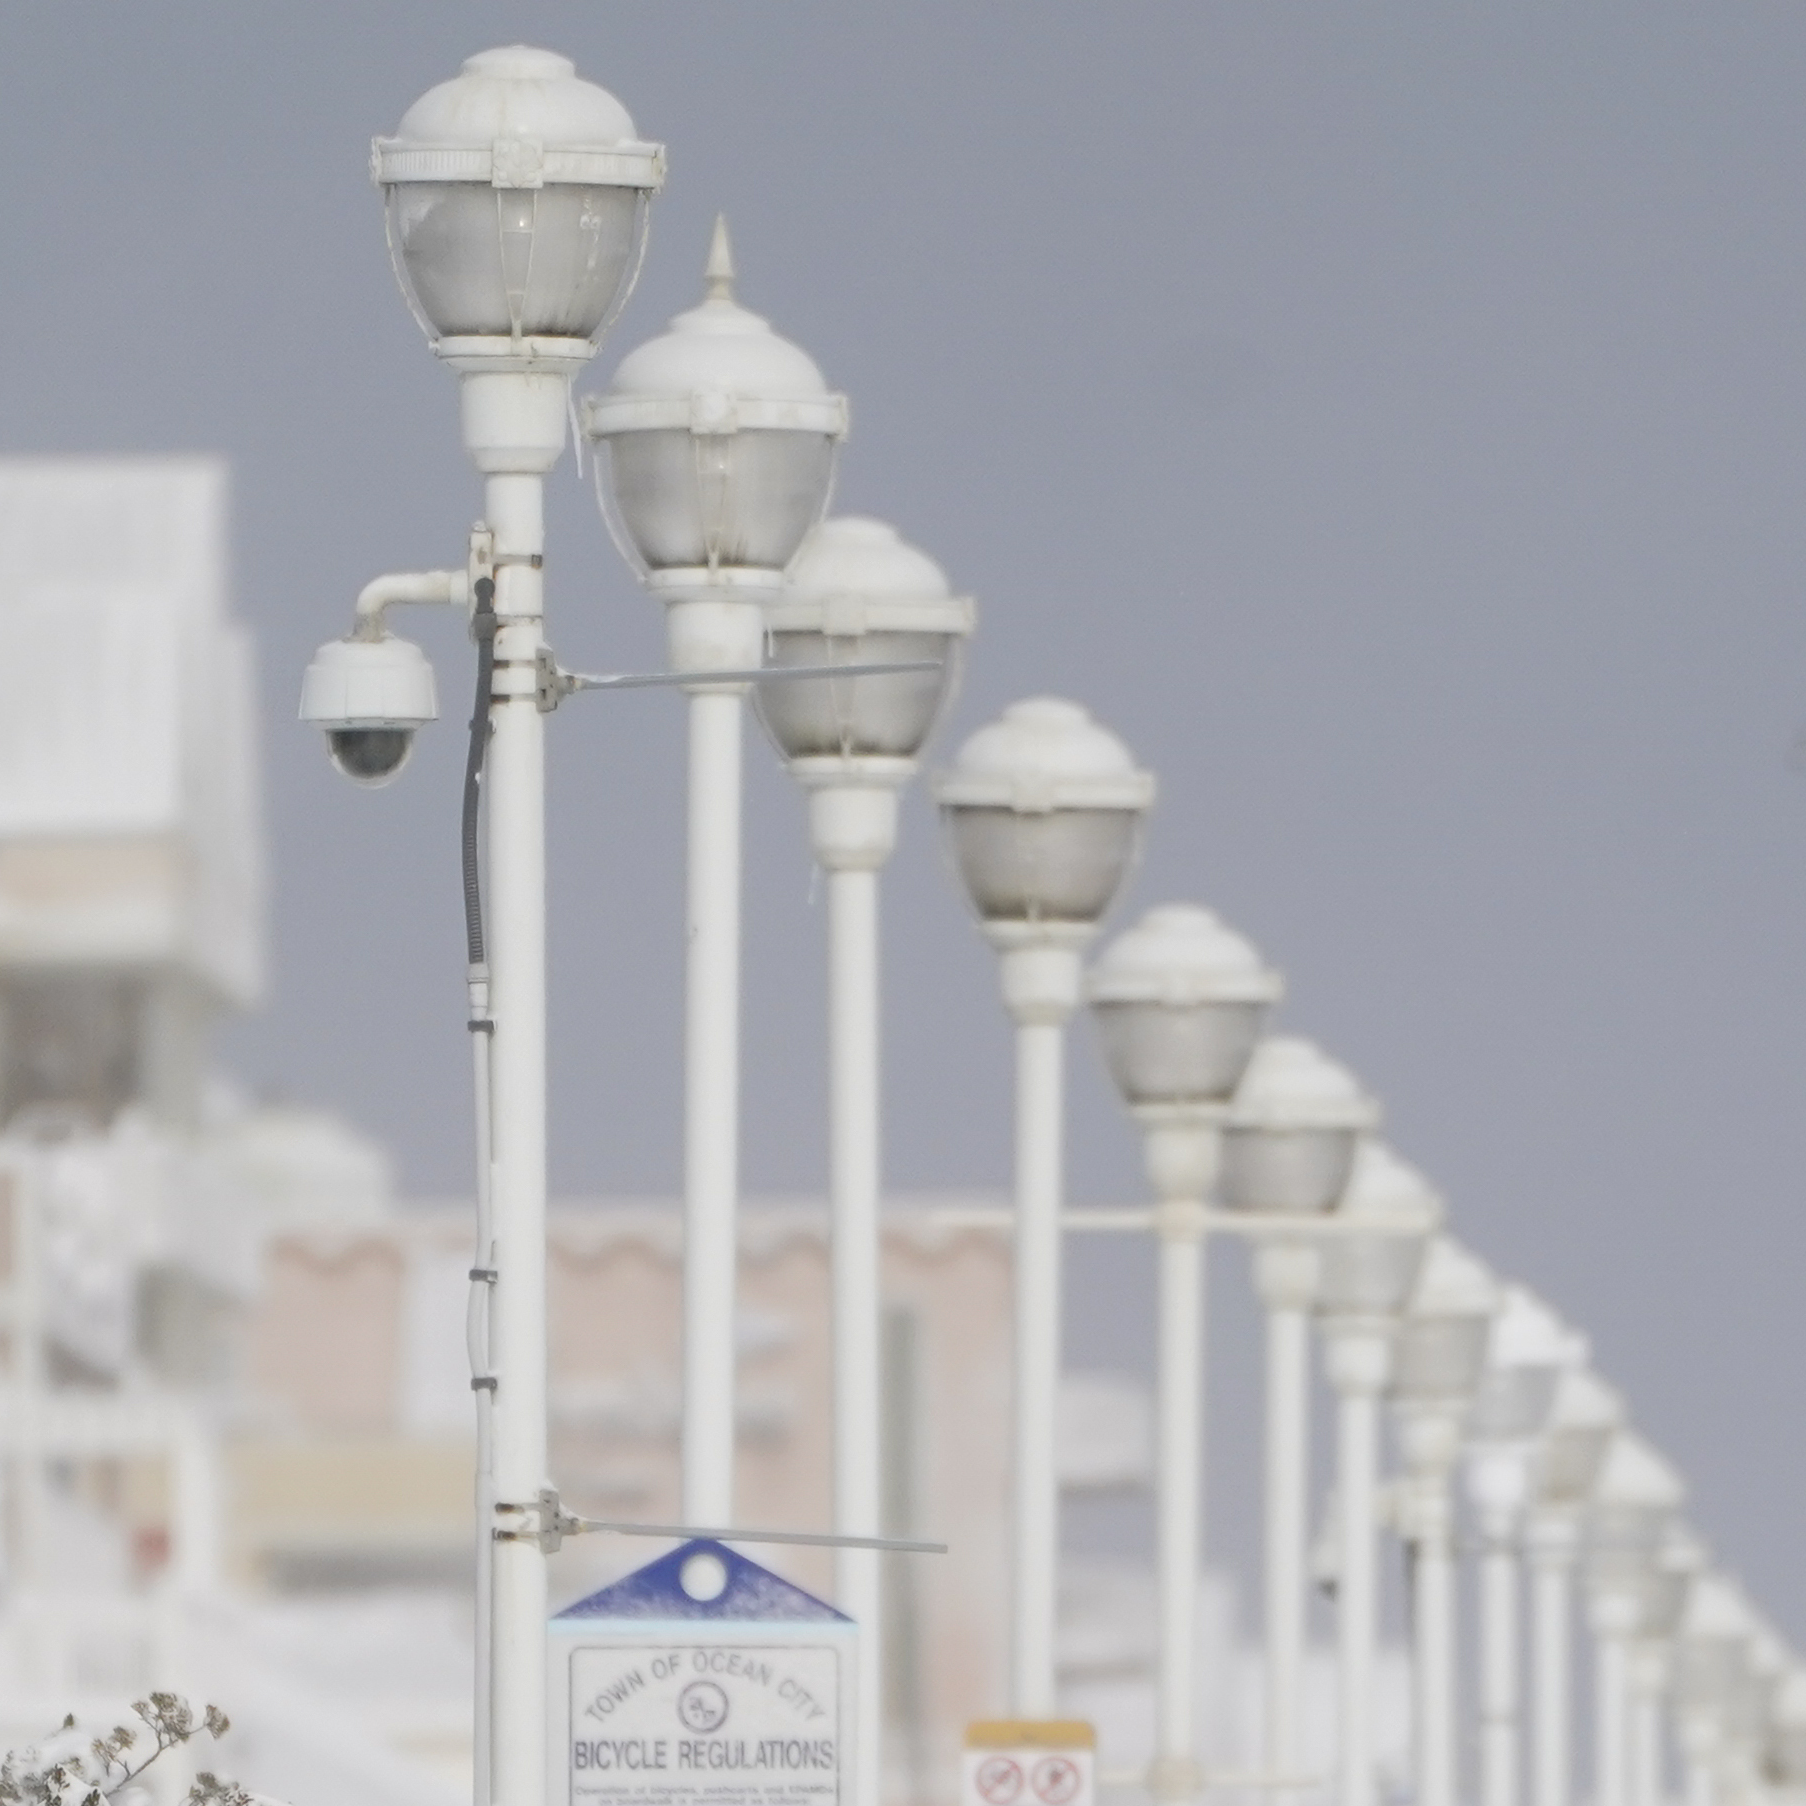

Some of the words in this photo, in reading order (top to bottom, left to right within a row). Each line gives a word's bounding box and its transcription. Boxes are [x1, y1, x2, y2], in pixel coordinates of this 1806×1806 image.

[584, 1670, 645, 1723] TOWN
[651, 1653, 681, 1680] OF
[692, 1650, 771, 1687] OCEAN
[777, 1678, 826, 1722] CITY
[574, 1740, 668, 1770] BICYCLE
[678, 1740, 833, 1770] REGULATIONS
